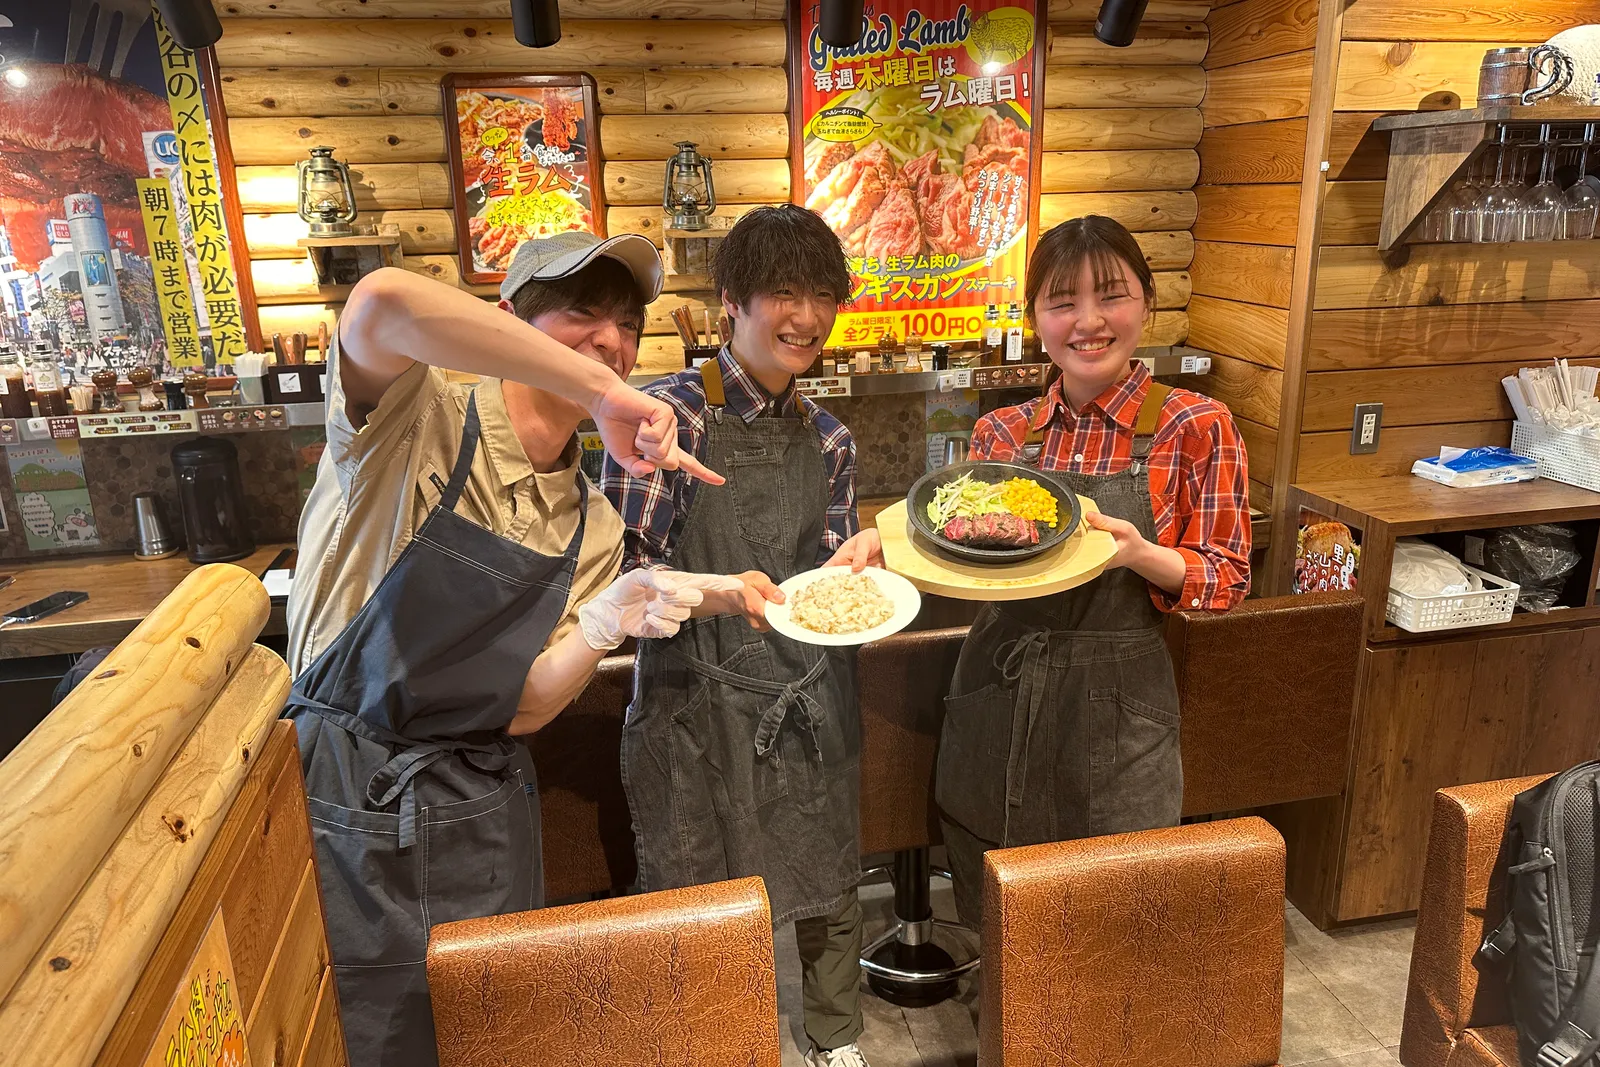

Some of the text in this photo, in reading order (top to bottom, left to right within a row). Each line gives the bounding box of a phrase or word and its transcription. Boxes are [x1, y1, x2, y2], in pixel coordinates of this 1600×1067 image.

[900, 5, 971, 52] Lamb
[813, 55, 956, 92] 毎週木曜日は
[920, 73, 1030, 113] ラム曜日!
[482, 163, 573, 199] 生ラム
[143, 187, 198, 359] 朝7時まで営業
[885, 253, 960, 273] 生ラム肉の
[851, 273, 1017, 303] ンギスカン ステーキ
[843, 327, 898, 343] 全グラム
[848, 316, 896, 327] ラム曜日限定!
[901, 312, 981, 339] 100円O
[103, 345, 139, 357] ステーキ
